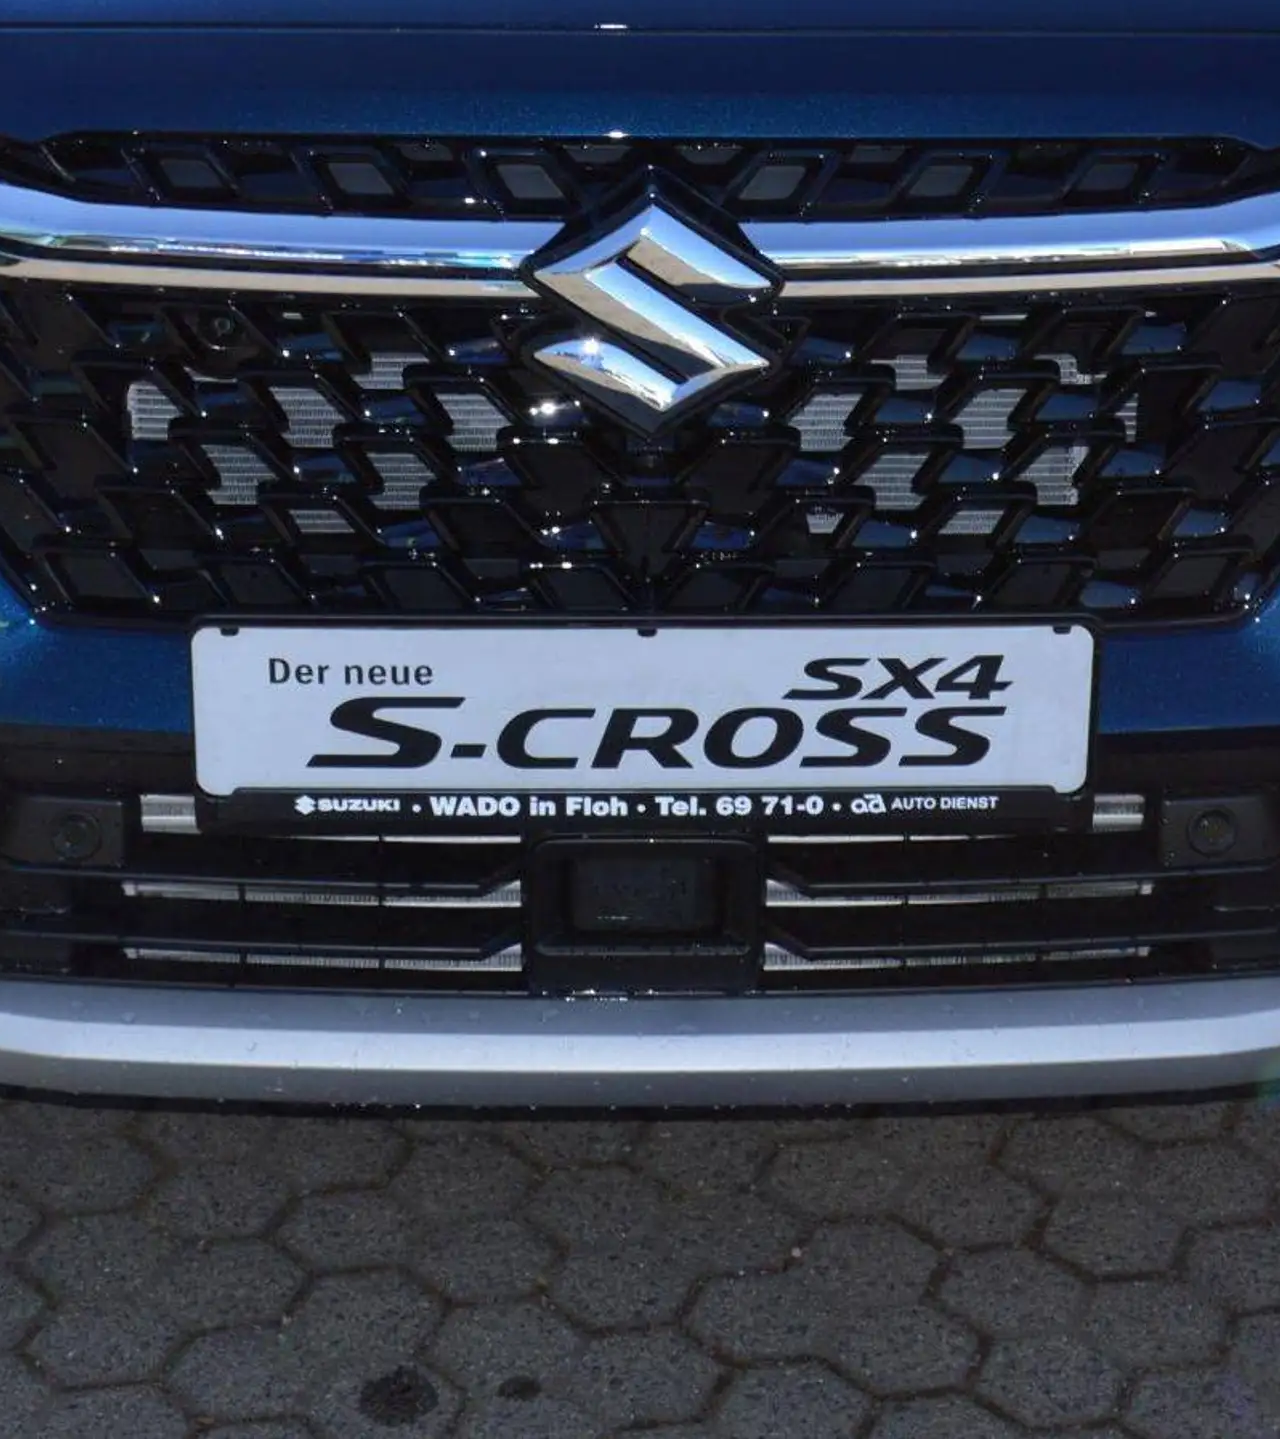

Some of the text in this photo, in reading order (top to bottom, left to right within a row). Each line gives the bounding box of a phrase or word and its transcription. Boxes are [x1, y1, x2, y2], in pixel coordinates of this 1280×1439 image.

[267, 656, 434, 686] Der neue
[781, 654, 1014, 701] SX4
[305, 696, 1008, 769] S-CROSS
[317, 798, 401, 812] SUZUKI
[429, 795, 521, 817] WADO
[528, 796, 557, 817] in
[565, 795, 629, 817] Floh
[654, 795, 707, 817] Tel.
[715, 795, 753, 816] 69
[761, 794, 825, 816] 71-0
[891, 796, 937, 811] AUTO
[939, 795, 1000, 811] DIENST
